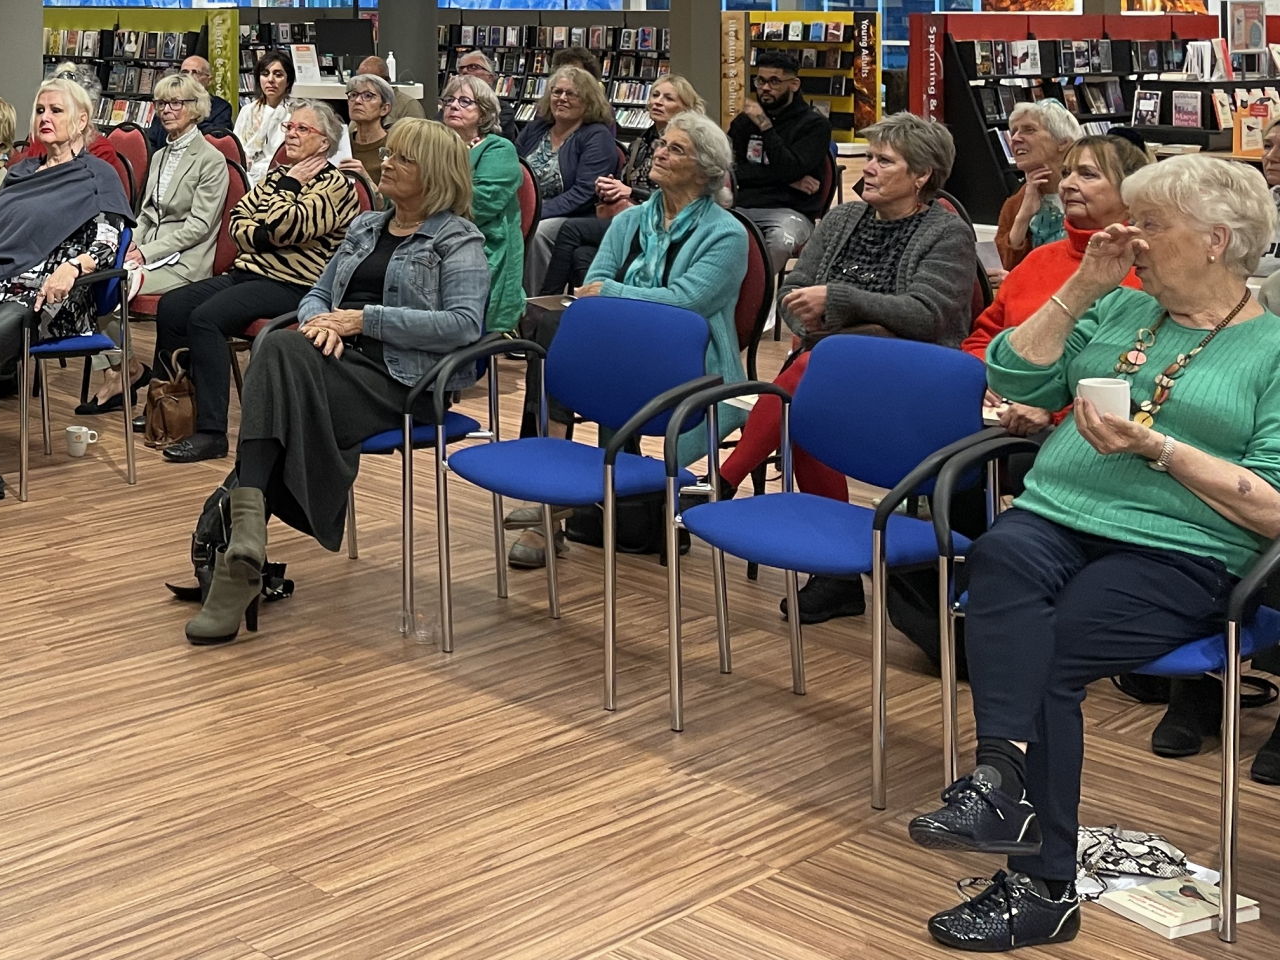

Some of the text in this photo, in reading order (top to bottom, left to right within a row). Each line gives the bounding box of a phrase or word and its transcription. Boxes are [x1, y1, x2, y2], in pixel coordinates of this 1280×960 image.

[728, 19, 737, 117] Literatuur & Cultuur
[859, 19, 870, 78] Young Adults
[927, 25, 937, 95] Spanning
[215, 71, 223, 97] Leve
[929, 98, 938, 111] &
